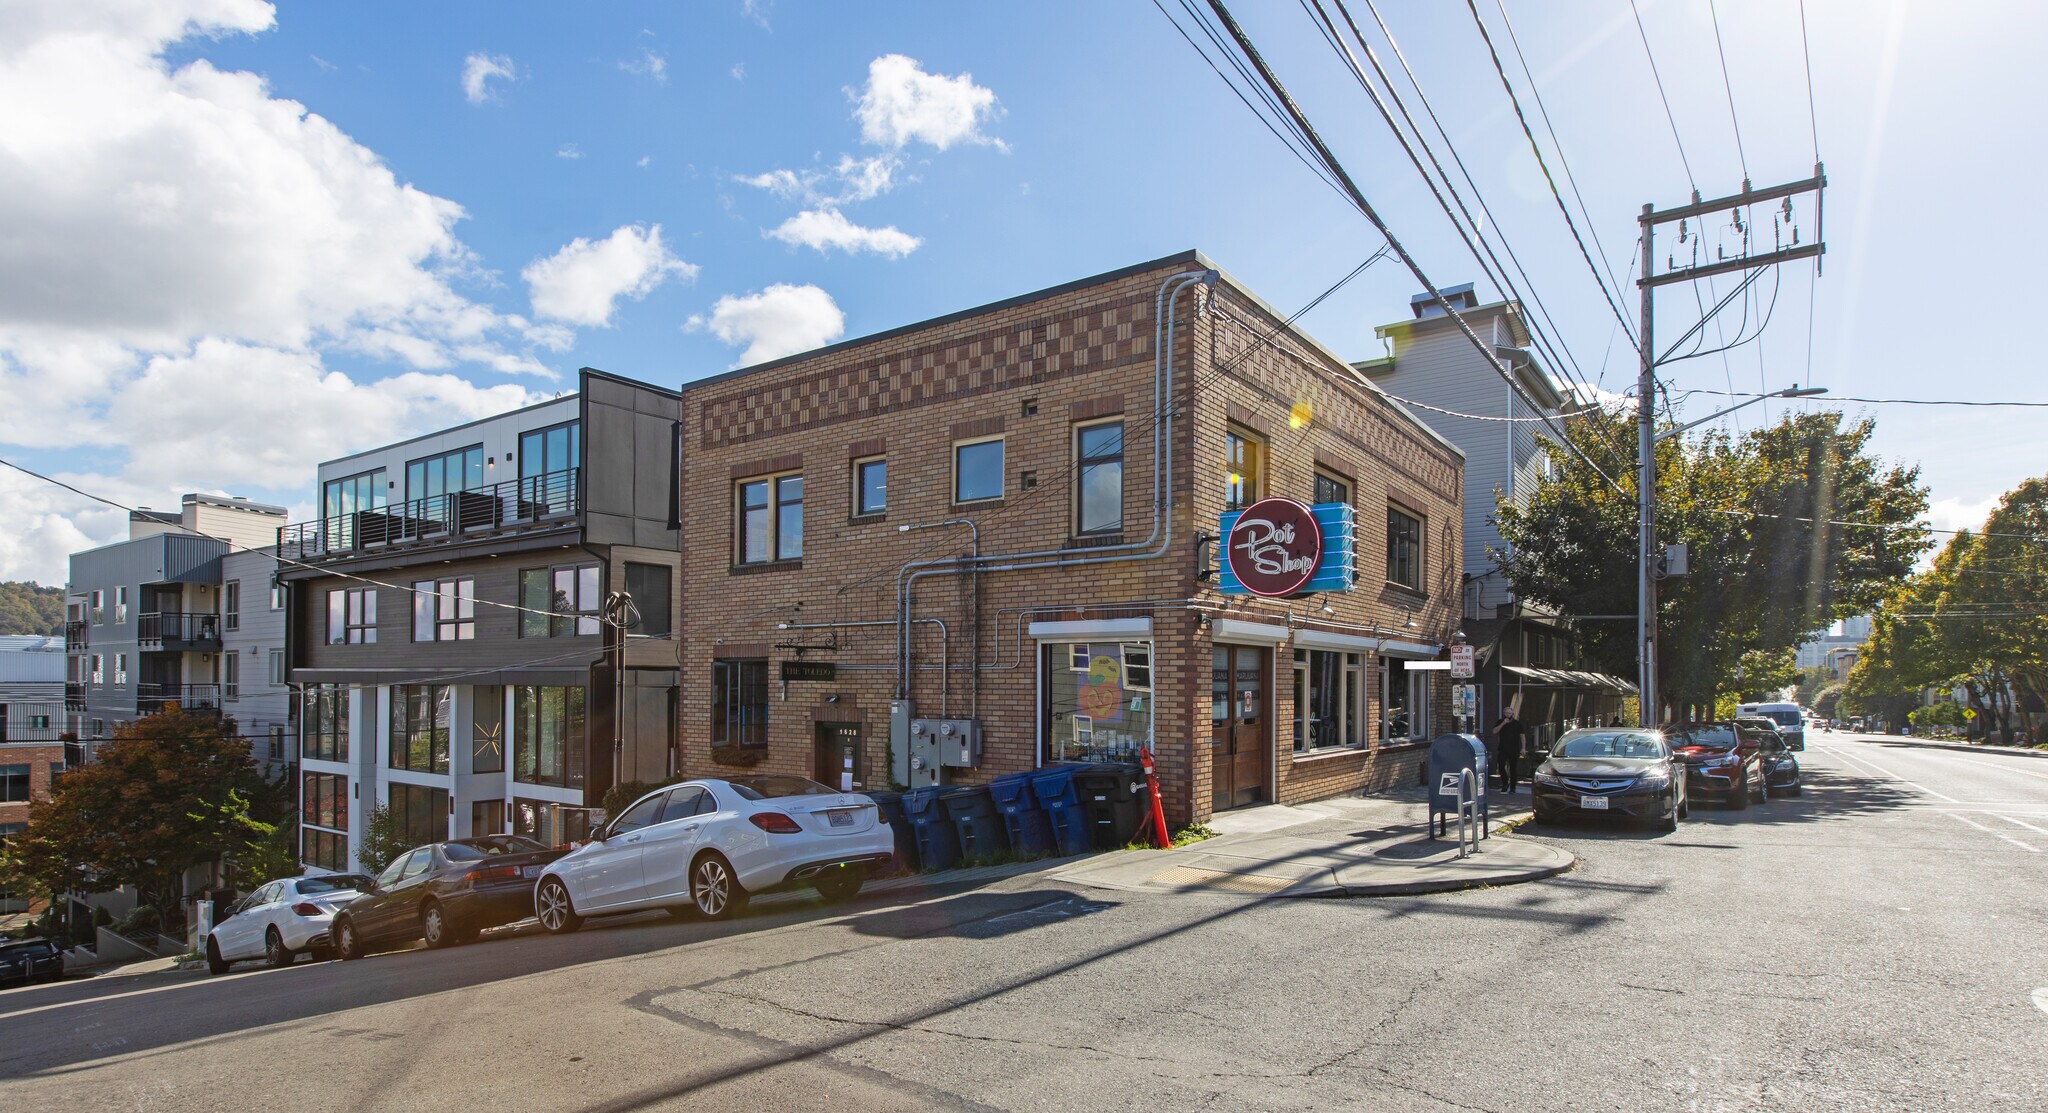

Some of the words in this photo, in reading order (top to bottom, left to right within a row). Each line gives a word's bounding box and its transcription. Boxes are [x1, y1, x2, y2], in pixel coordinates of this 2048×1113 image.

[1234, 519, 1295, 559] Pot
[1254, 545, 1312, 575] Shop
[786, 667, 799, 675] THE
[804, 667, 831, 676] TOLEDO
